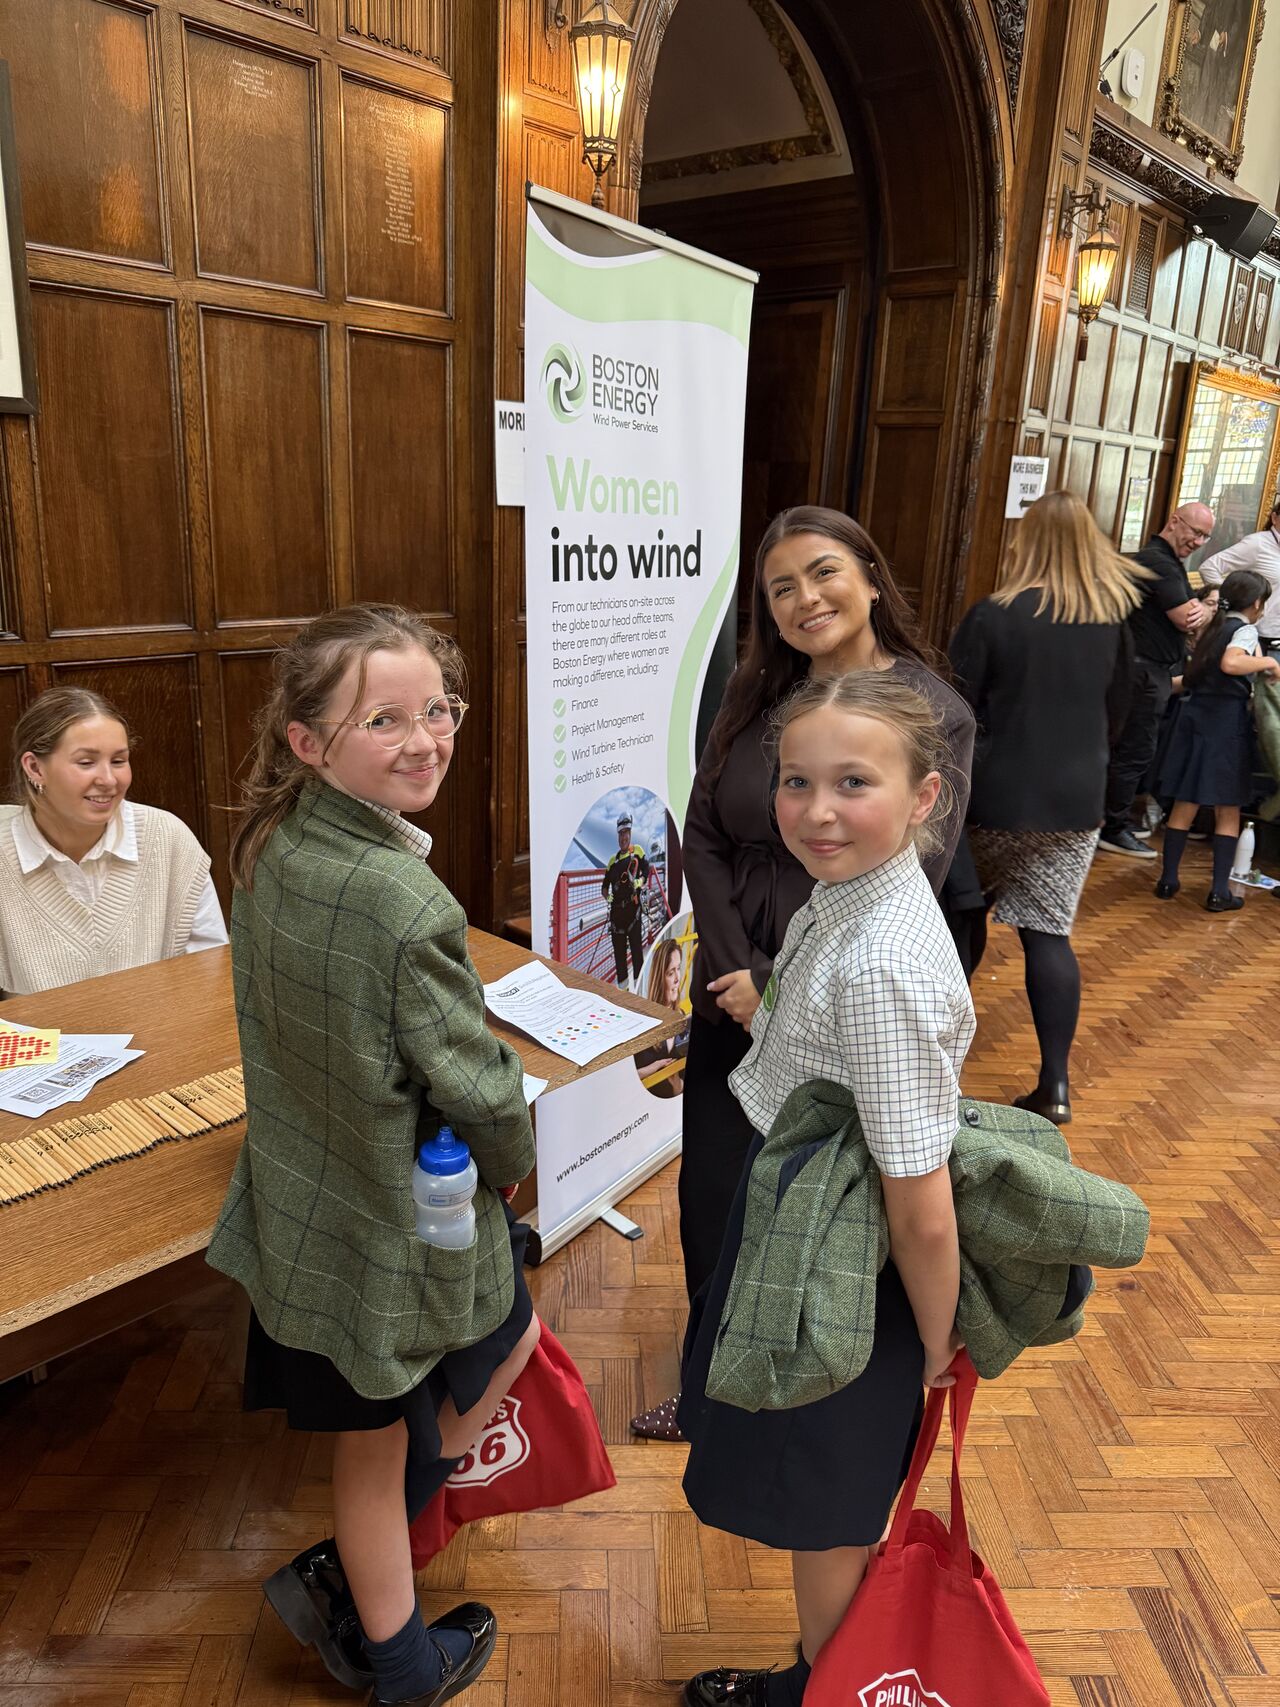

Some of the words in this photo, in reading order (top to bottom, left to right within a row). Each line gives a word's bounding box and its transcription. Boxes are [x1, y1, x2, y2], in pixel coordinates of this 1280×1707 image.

[592, 353, 659, 391] BOSTON
[592, 382, 659, 417] ENERGY
[593, 413, 610, 426] Wind
[611, 416, 631, 430] Power
[632, 420, 659, 434] Services
[546, 454, 679, 516] Women
[551, 526, 618, 582] into
[627, 529, 702, 579] wind
[552, 601, 575, 613] From
[576, 602, 588, 612] our
[590, 598, 628, 610] technicians
[629, 596, 653, 608] on-site
[654, 596, 675, 606] across
[552, 620, 567, 632] the
[569, 618, 590, 634] globe
[591, 619, 599, 629] to
[600, 618, 611, 628] our
[612, 613, 631, 627] head
[632, 612, 652, 625] office
[552, 638, 576, 651] there
[577, 639, 589, 649] are
[590, 636, 609, 648] many
[610, 631, 640, 645] different
[642, 628, 658, 640] roles
[659, 629, 667, 639] at
[553, 657, 581, 670] Boston
[583, 654, 607, 667] Energy
[608, 649, 630, 662] where
[631, 647, 657, 659] women
[658, 646, 670, 656] are
[553, 674, 583, 688] making
[584, 674, 589, 683] a
[571, 698, 599, 711] Finance
[571, 722, 596, 736] Project
[597, 712, 645, 730] Management
[571, 746, 591, 761] Wind
[591, 741, 616, 756] Turbine
[617, 733, 654, 749] Technician
[571, 768, 595, 786] Health
[595, 767, 601, 779] &
[602, 762, 625, 777] Safety
[556, 1112, 650, 1183] www.bostonenergy.com
